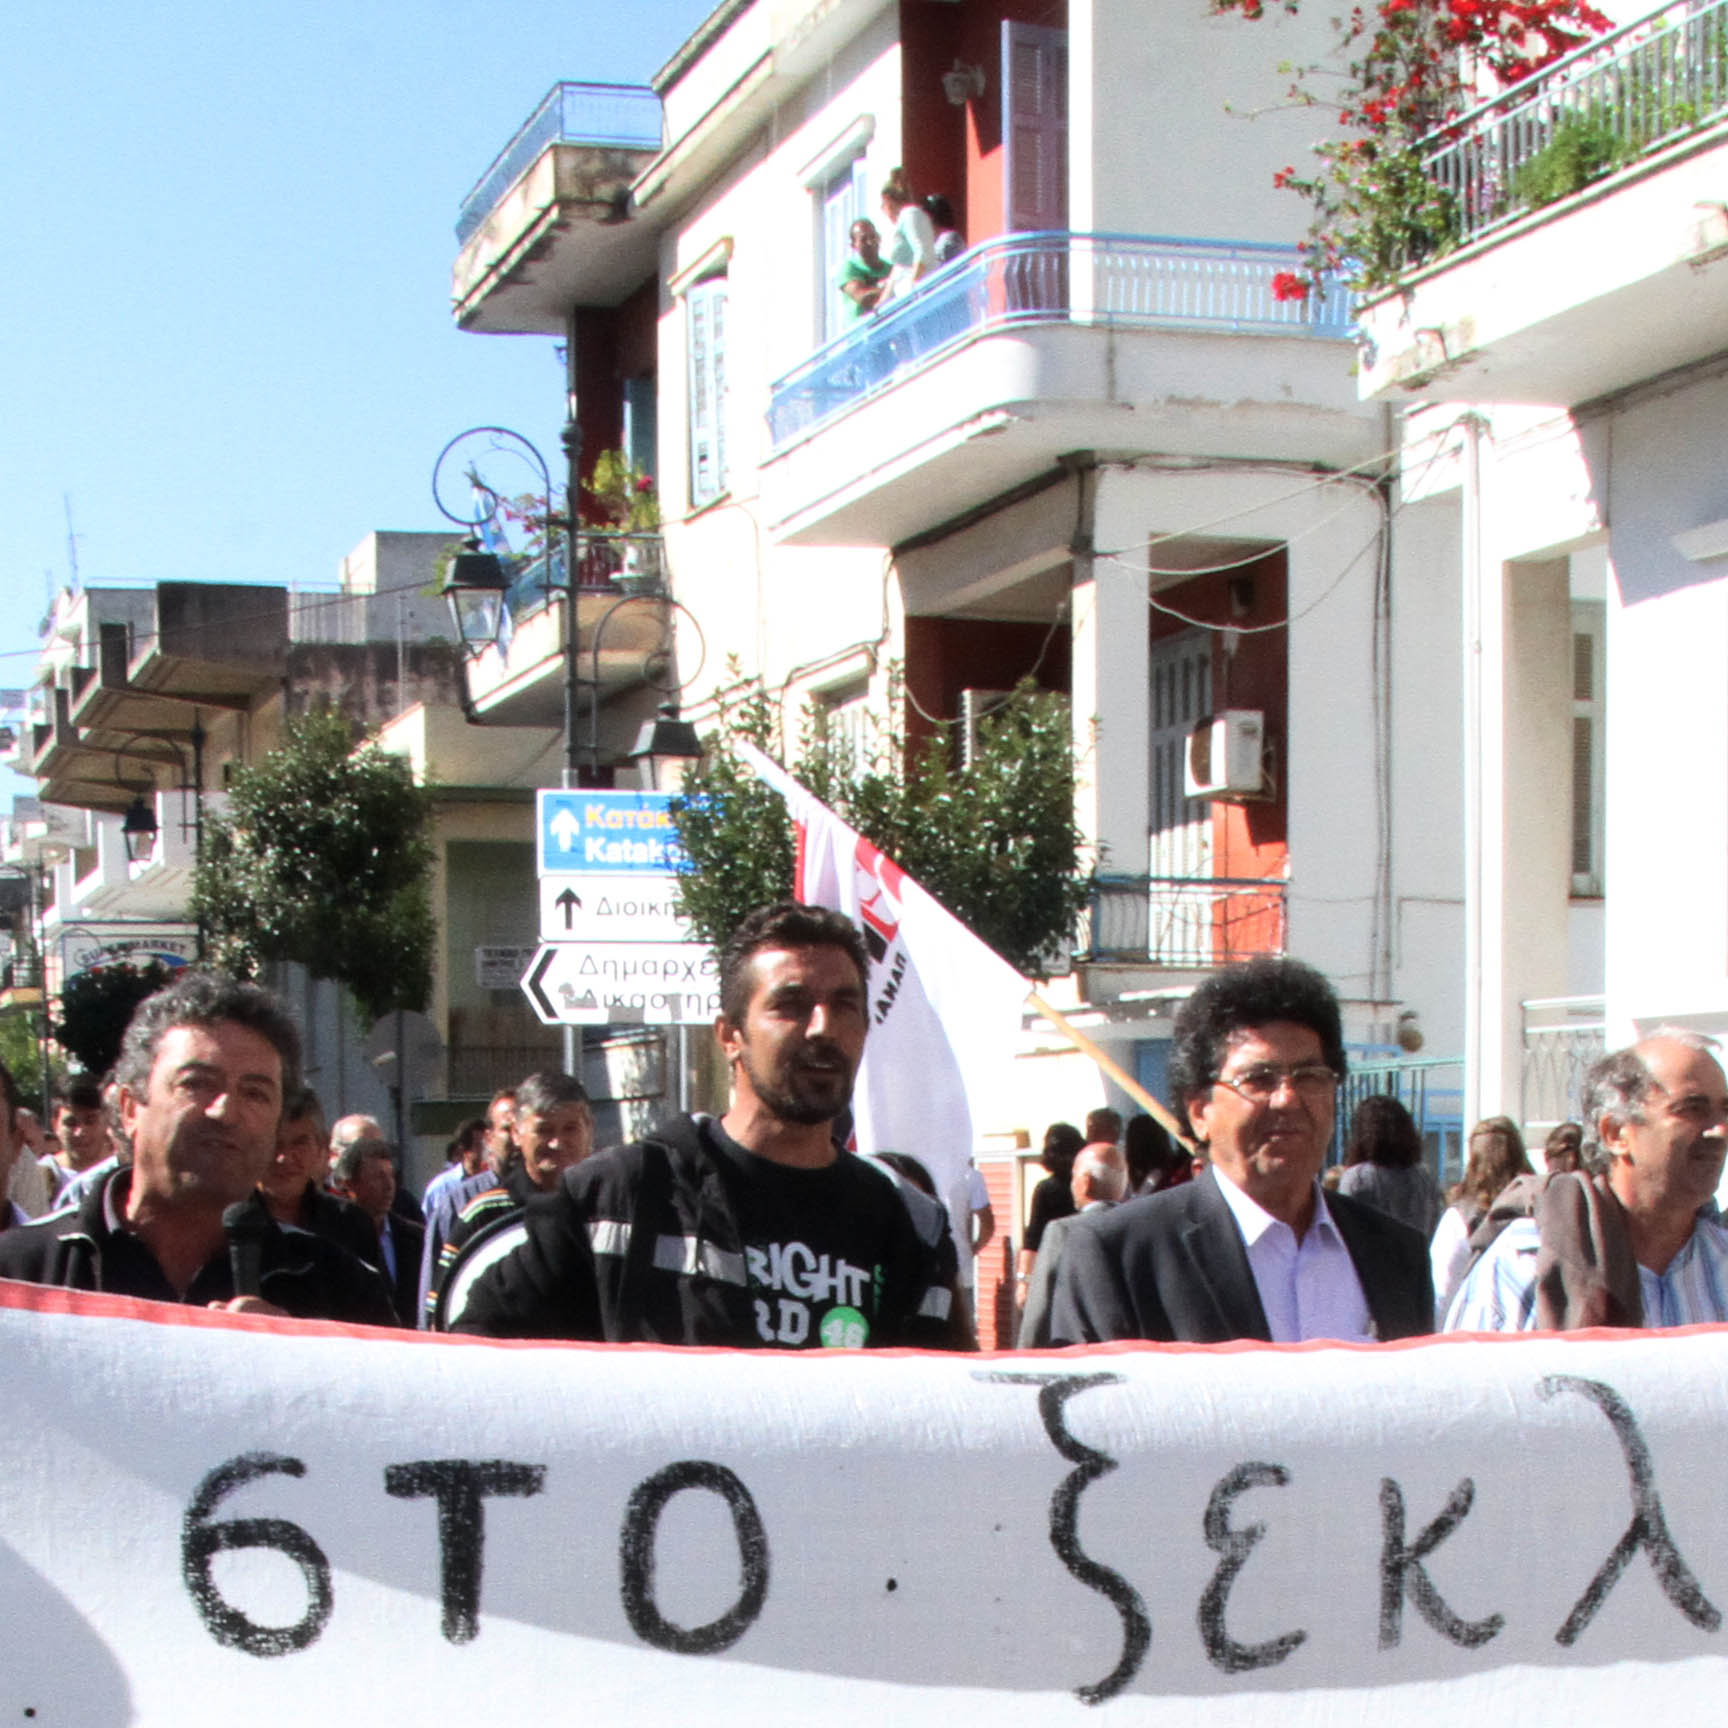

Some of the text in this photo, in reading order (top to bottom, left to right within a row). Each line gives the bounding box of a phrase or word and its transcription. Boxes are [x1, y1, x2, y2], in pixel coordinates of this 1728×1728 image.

[585, 803, 673, 829] Κατάκ
[585, 838, 682, 863] Katako
[596, 896, 677, 916] Διοικη
[579, 954, 718, 982] Δημαρχε
[579, 988, 722, 1017] Δικασηρ
